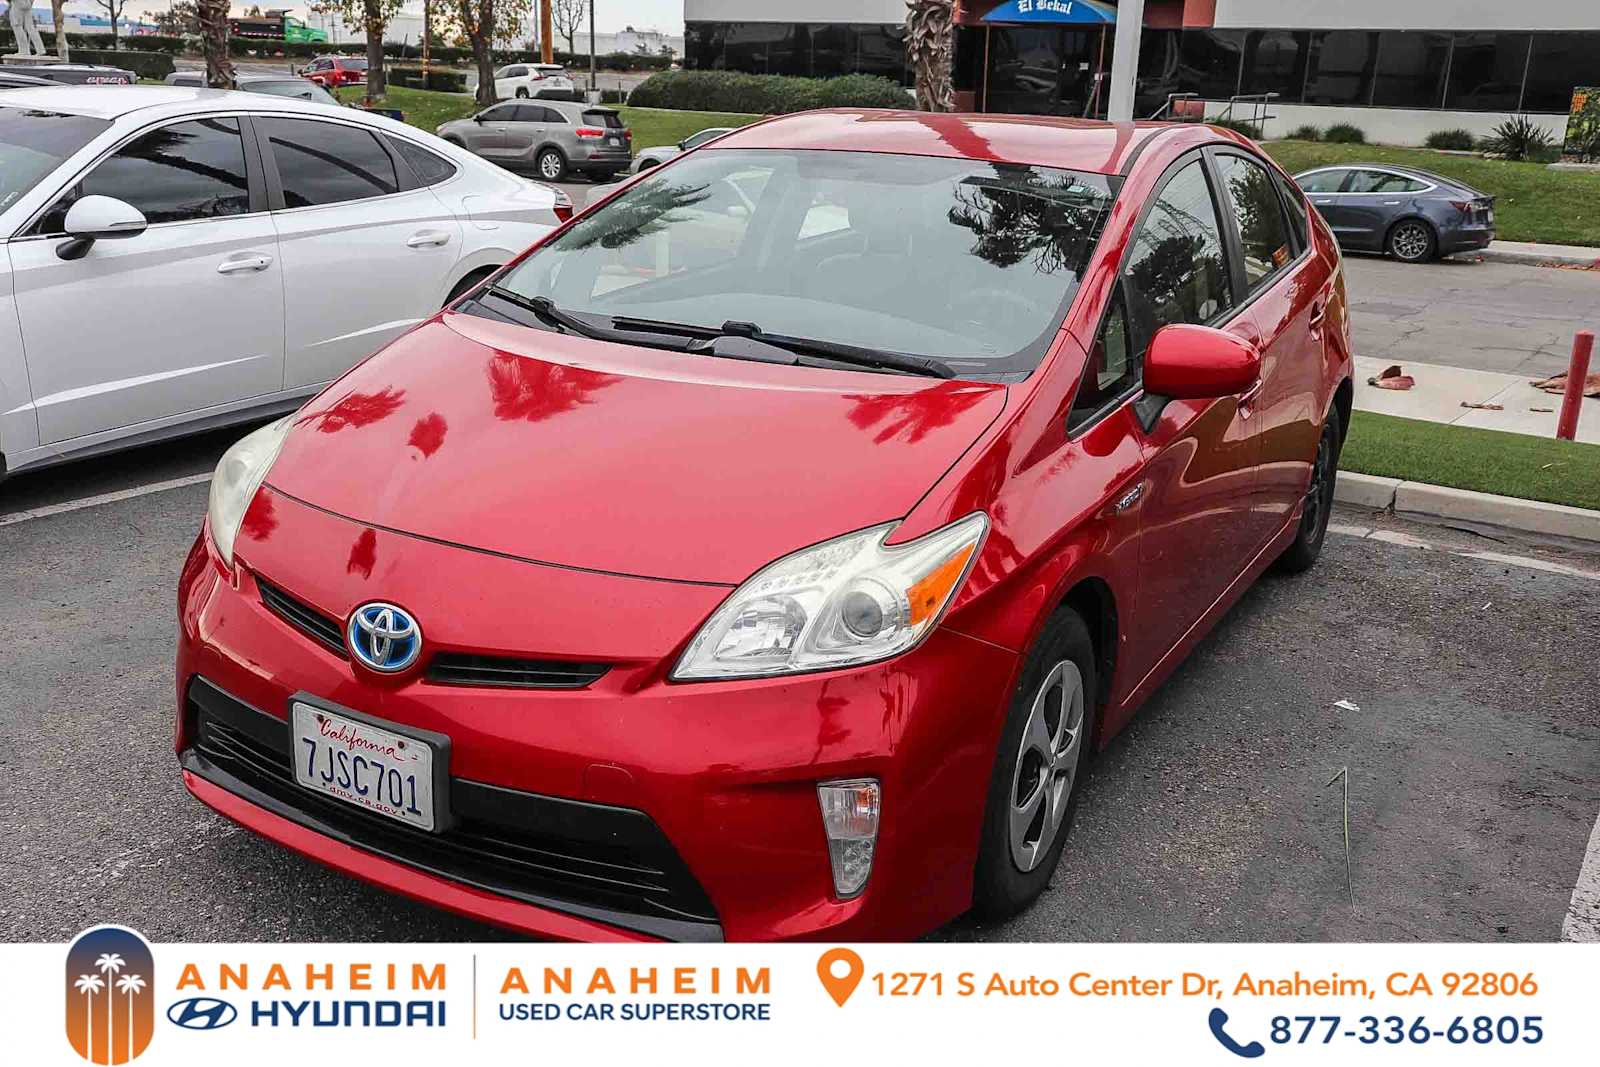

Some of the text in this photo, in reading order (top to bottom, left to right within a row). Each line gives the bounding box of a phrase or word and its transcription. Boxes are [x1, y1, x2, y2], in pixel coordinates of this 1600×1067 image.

[1018, 0, 1032, 13] El
[319, 717, 406, 763] California
[302, 737, 422, 817] 7JSC701
